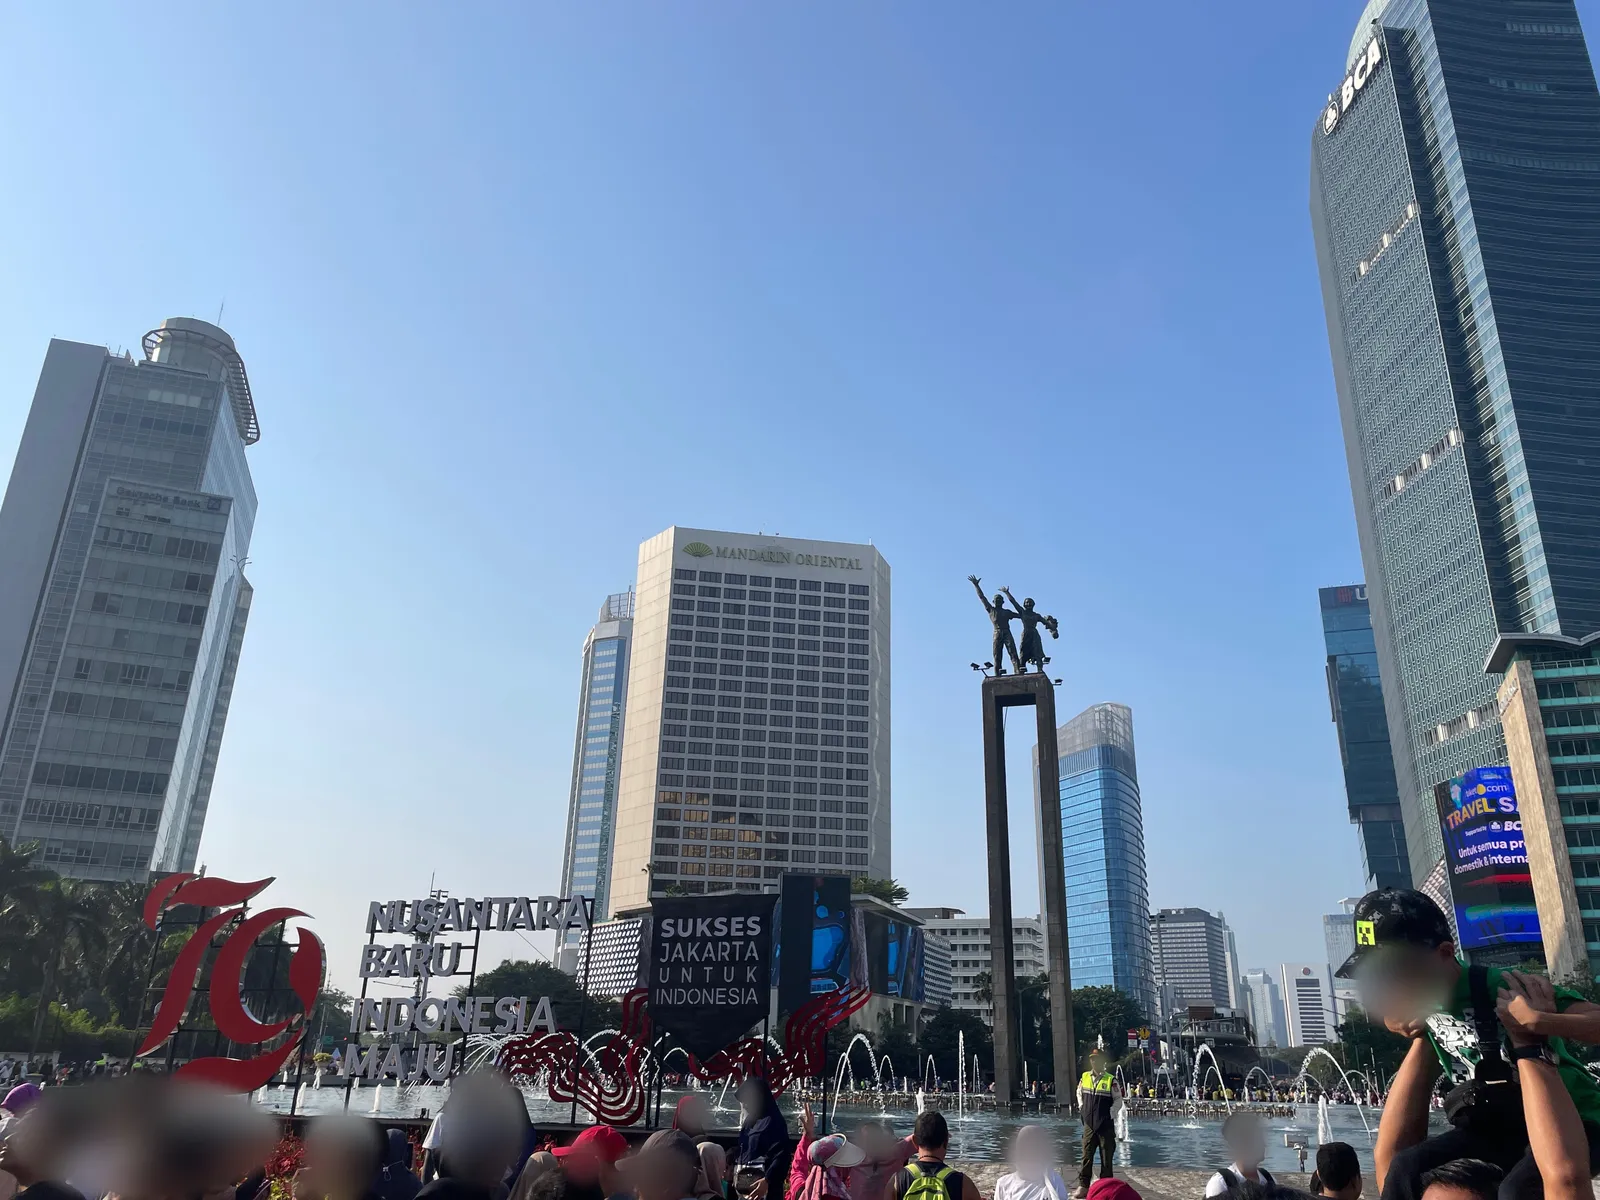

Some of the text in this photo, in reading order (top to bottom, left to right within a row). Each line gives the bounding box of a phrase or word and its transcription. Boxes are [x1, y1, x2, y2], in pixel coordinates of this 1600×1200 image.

[1341, 37, 1381, 113] BCA
[715, 545, 863, 571] MANDARIN ORIENTAL
[1446, 796, 1520, 830] TRAVEL S
[1504, 821, 1523, 832] BC
[1458, 845, 1478, 859] Untuk
[1478, 841, 1507, 852] semua
[1454, 858, 1483, 875] domestik
[365, 895, 591, 933] NUSANTARA
[660, 916, 761, 938] SUKSES
[359, 942, 462, 978] BARU
[660, 941, 760, 963] JAKARTA
[655, 988, 759, 1006] INDONESIA
[349, 996, 558, 1034] INDONESIA
[342, 1043, 455, 1081] MAJU
